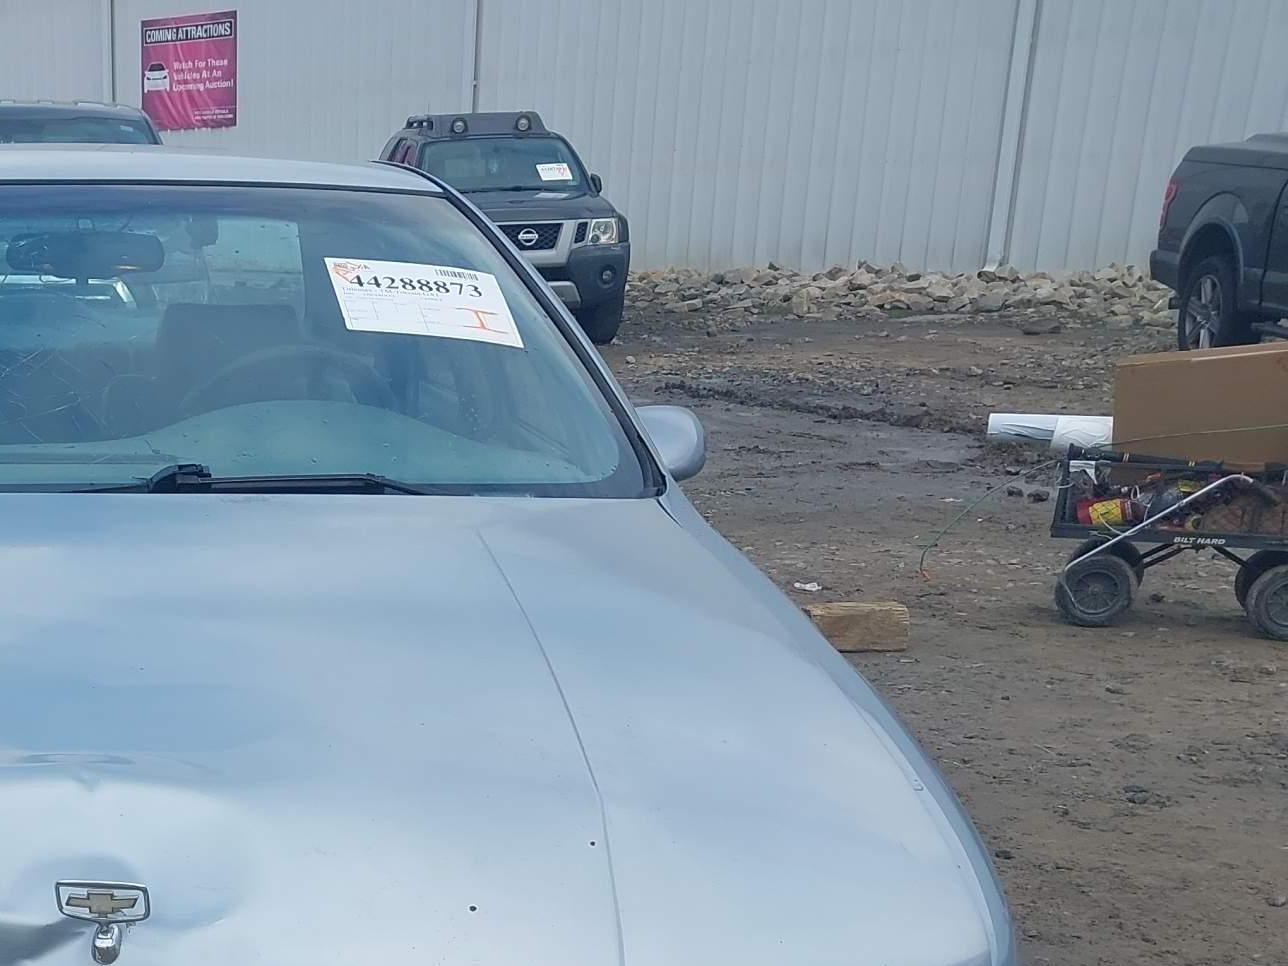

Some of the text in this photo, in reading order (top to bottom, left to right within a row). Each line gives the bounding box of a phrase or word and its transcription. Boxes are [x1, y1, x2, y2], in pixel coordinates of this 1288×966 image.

[146, 22, 231, 43] COMING ATTRACTIONS
[194, 59, 206, 68] For
[207, 58, 228, 67] These
[201, 69, 210, 79] At
[212, 69, 222, 77] An
[205, 79, 234, 88] Auction!
[349, 274, 483, 297] 44288873
[1173, 536, 1226, 545] BILT HARD
